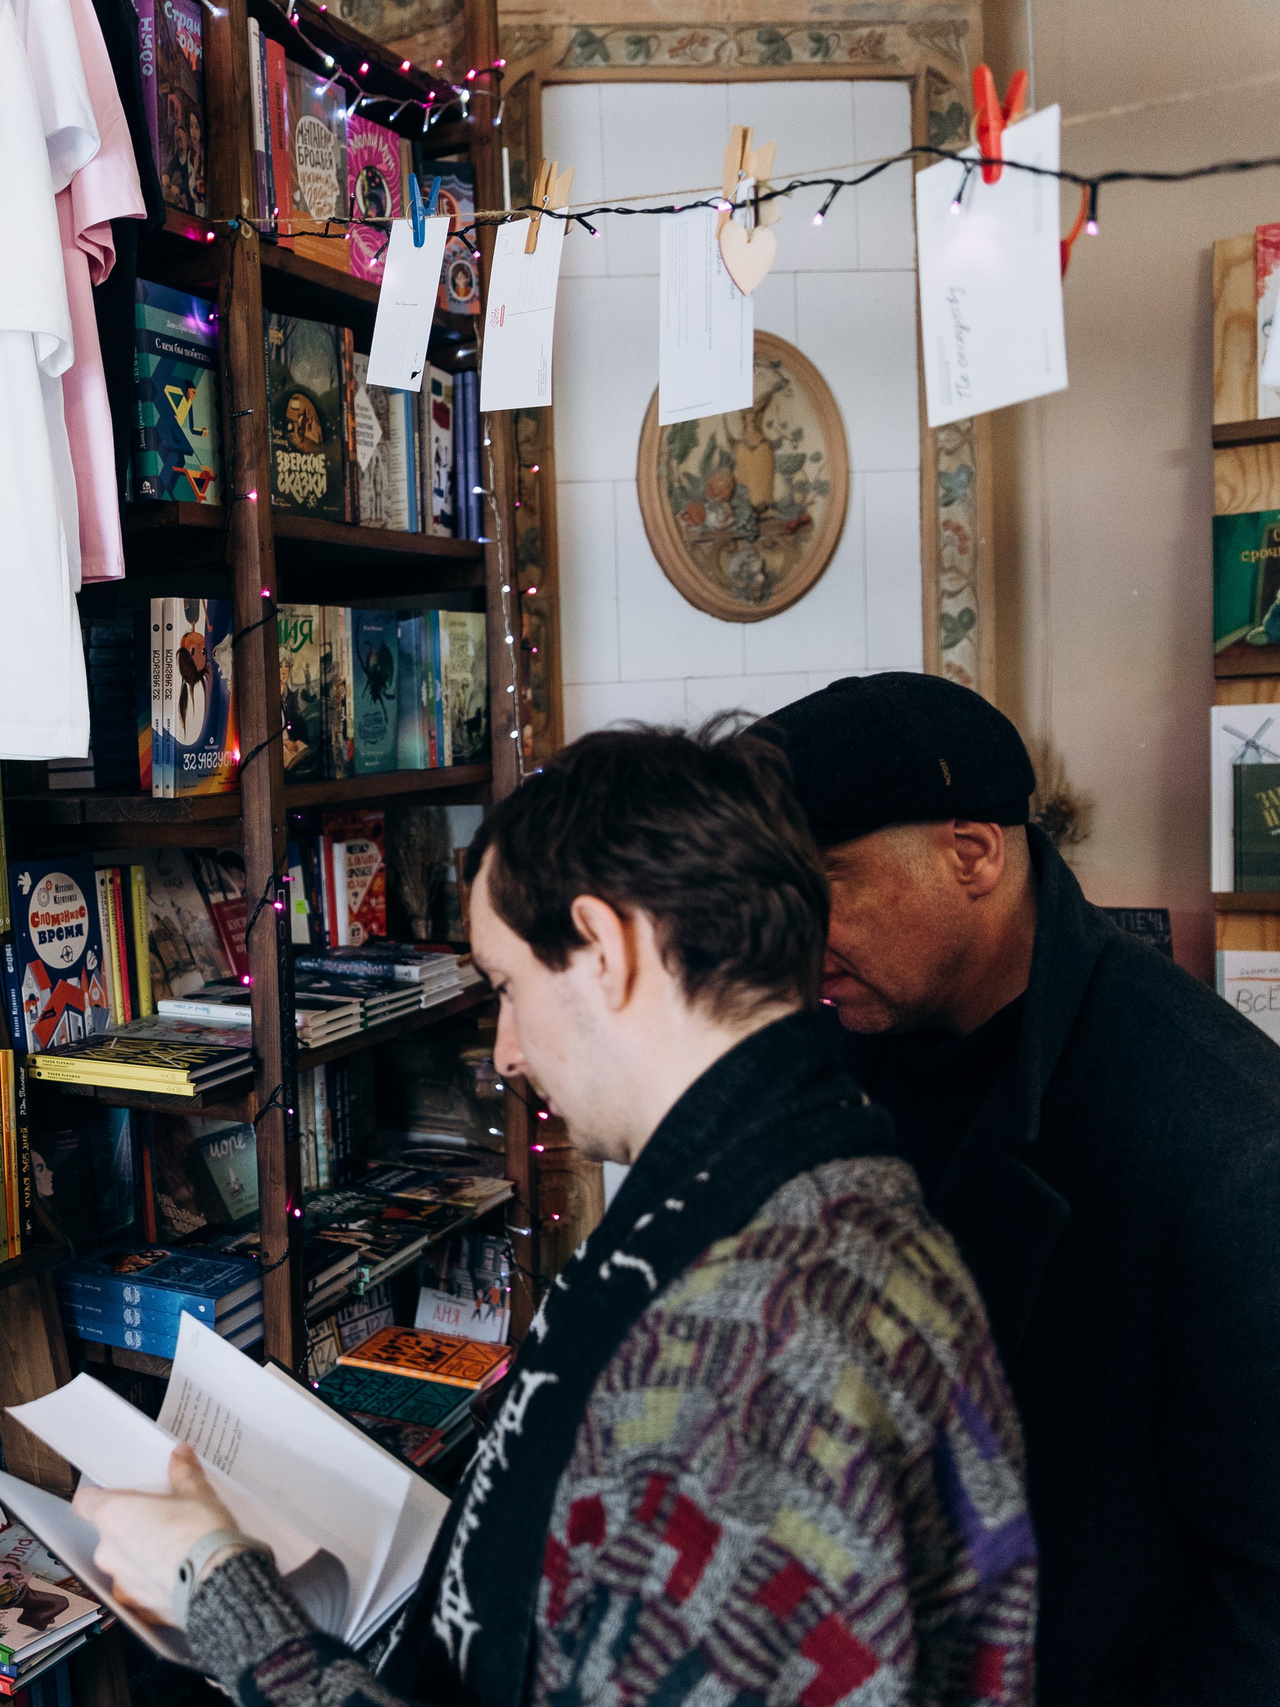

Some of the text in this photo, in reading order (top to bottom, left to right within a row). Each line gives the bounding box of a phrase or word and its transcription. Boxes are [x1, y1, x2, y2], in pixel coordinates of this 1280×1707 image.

[155, 337, 161, 349] С
[162, 342, 174, 352] кем
[174, 343, 184, 355] бы
[275, 451, 326, 474] ЗВЕРСКИЕ
[277, 471, 327, 503] СКАЗКИ
[183, 753, 197, 770] 32
